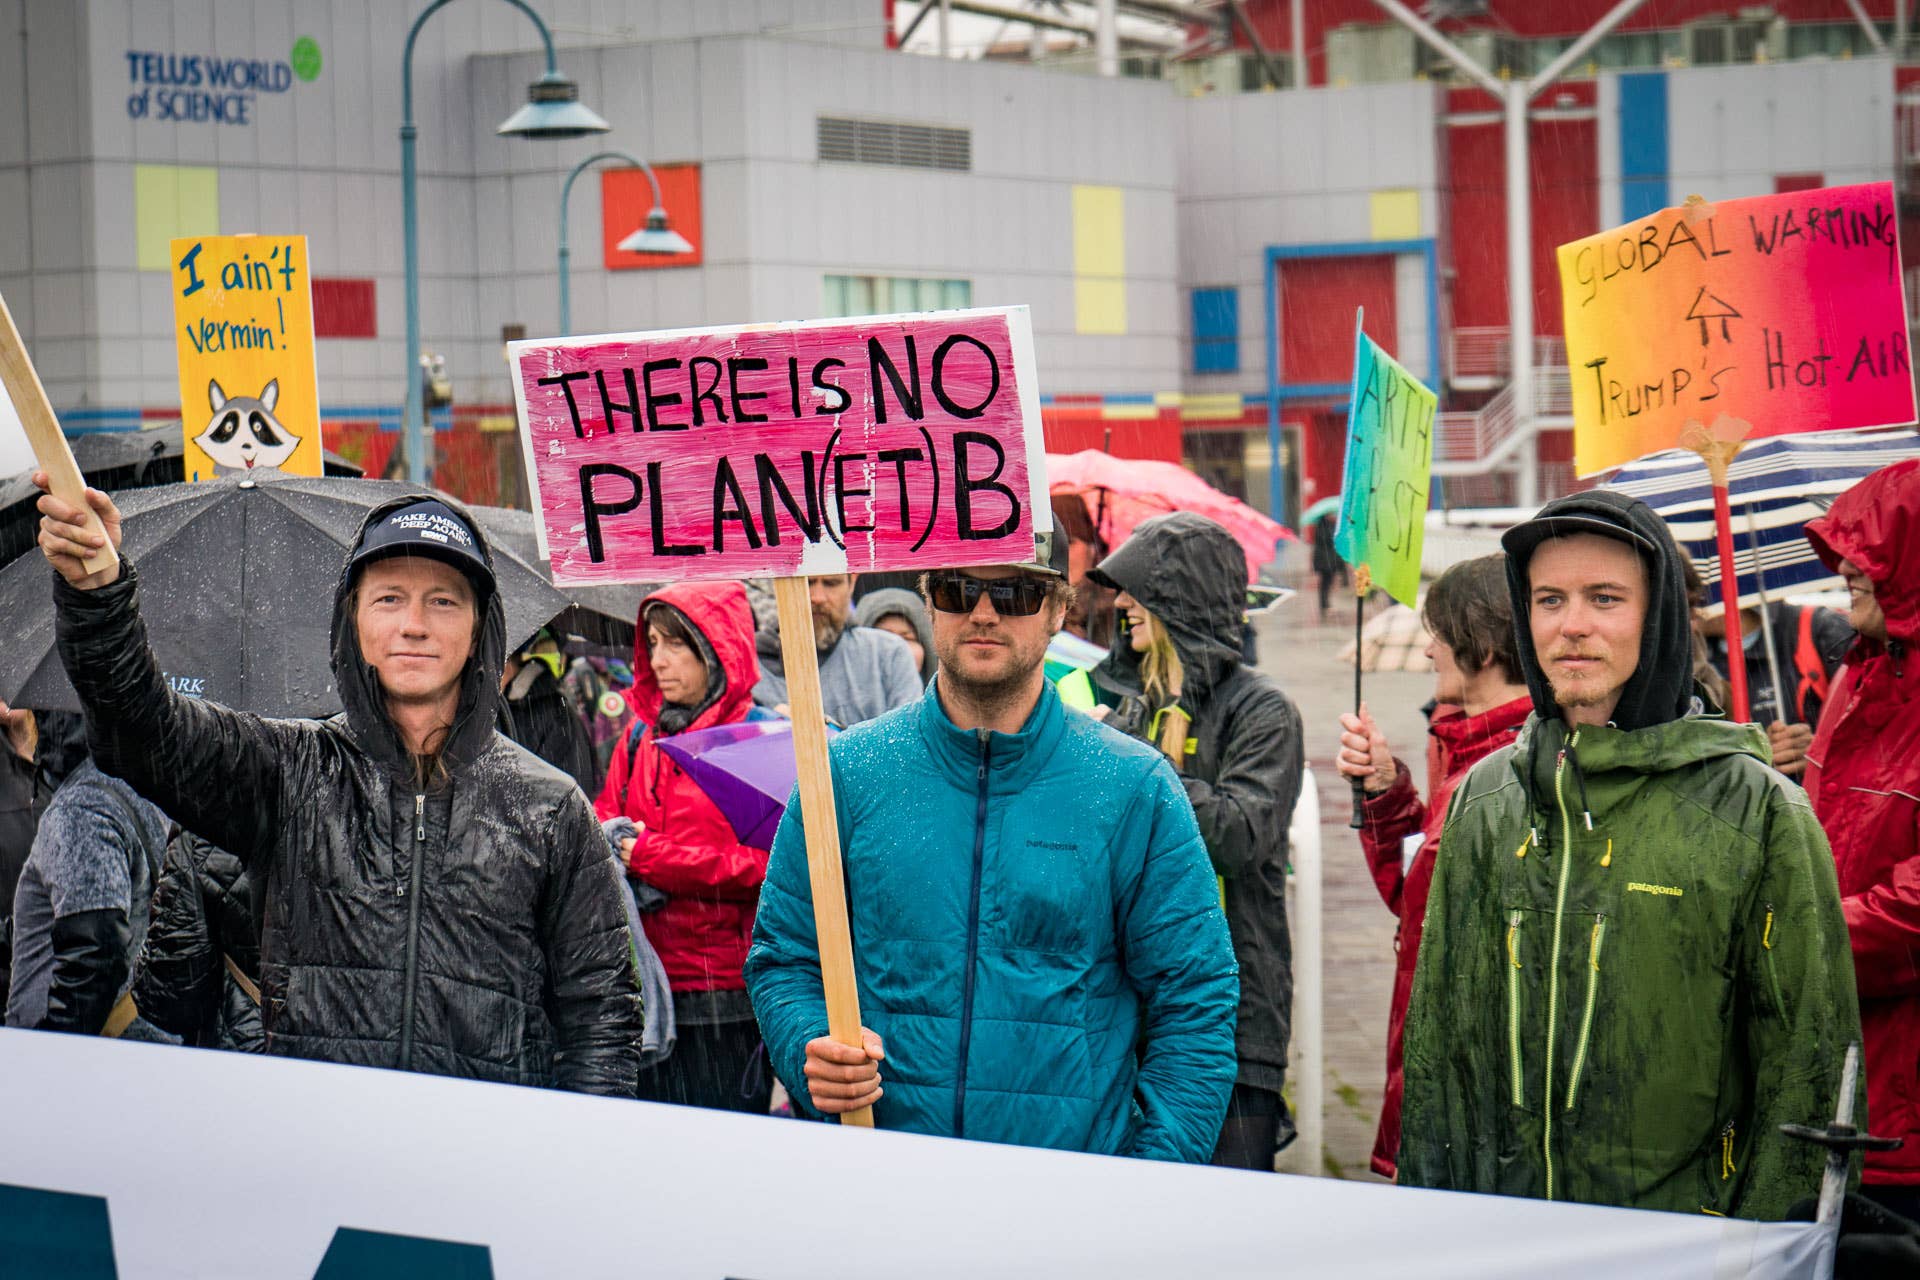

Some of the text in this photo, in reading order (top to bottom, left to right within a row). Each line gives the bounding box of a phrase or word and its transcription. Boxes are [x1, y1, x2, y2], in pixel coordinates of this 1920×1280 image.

[126, 51, 292, 93] TELUS WORLD
[127, 87, 251, 125] of SCIENCE
[179, 242, 296, 298] I ain't
[1576, 201, 1896, 307] GLOBAL WARMING
[1846, 332, 1910, 382] AIR
[538, 333, 1000, 439] THERE IS NO
[1358, 351, 1434, 469] ARTH
[579, 426, 1022, 563] PLAN(ET) B
[1346, 432, 1425, 562] IRST
[391, 513, 427, 525] MAKE
[428, 515, 472, 545] AMERICA
[400, 521, 431, 529] DEEP
[162, 671, 206, 693] ARK
[1627, 882, 1683, 896] patagonia
